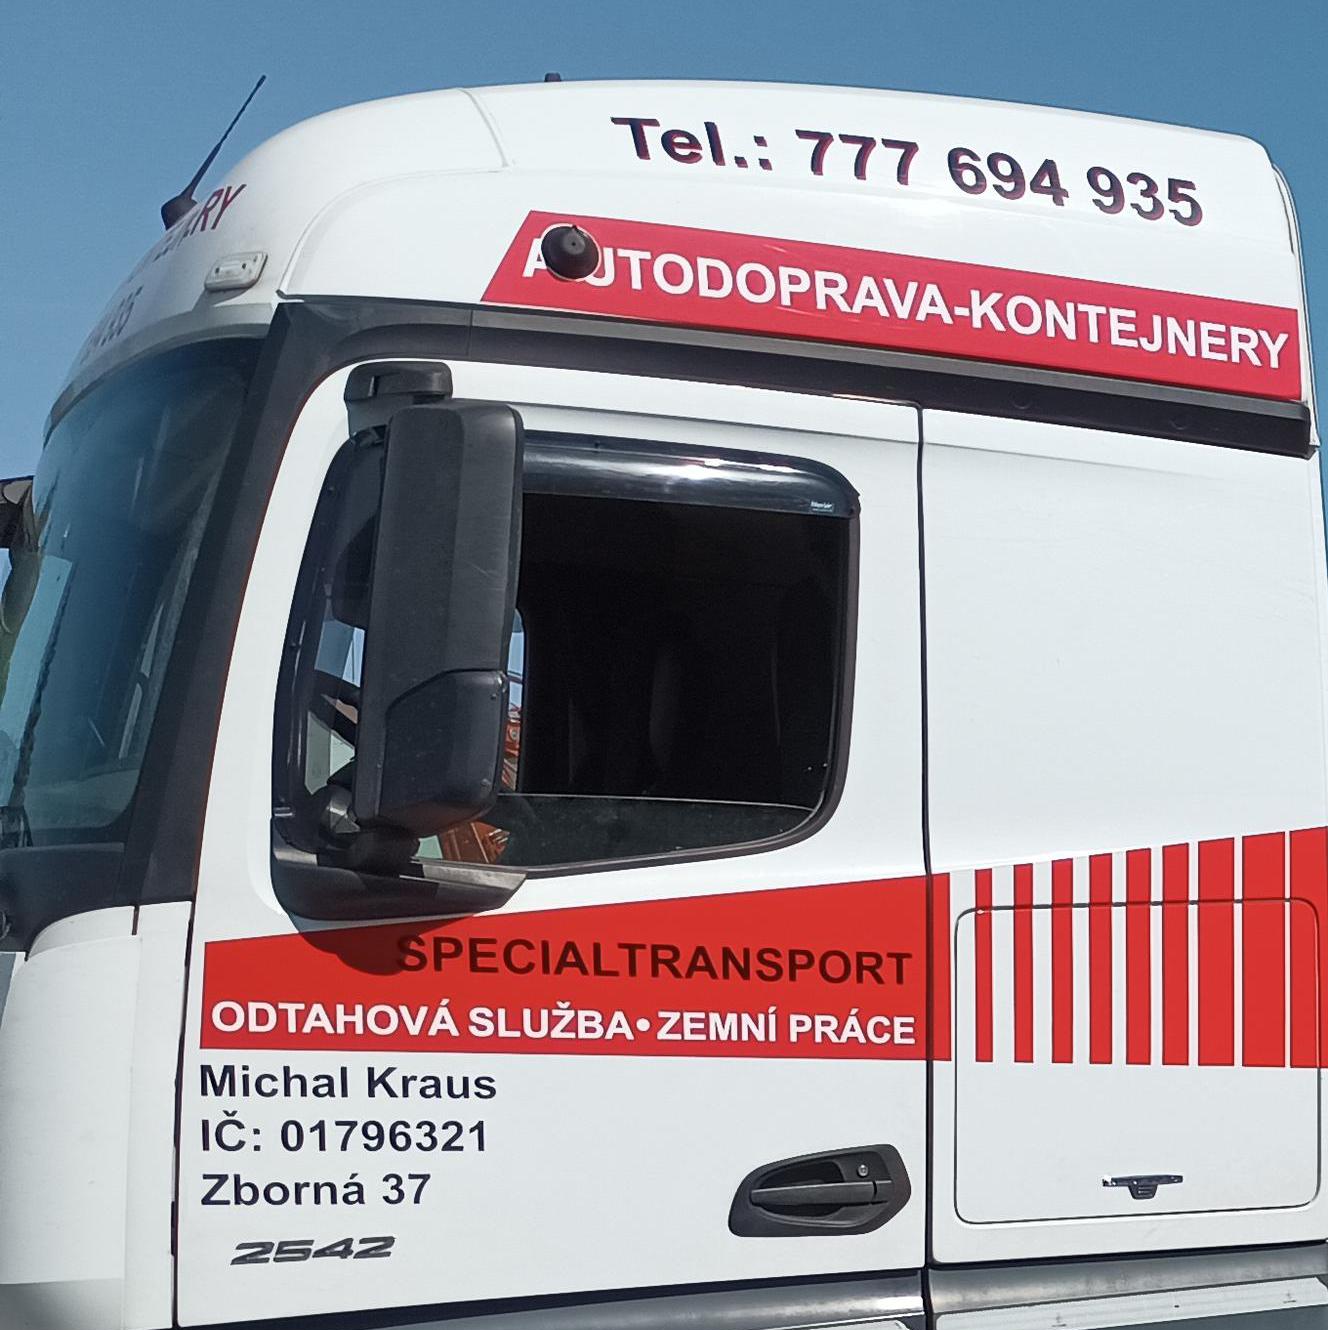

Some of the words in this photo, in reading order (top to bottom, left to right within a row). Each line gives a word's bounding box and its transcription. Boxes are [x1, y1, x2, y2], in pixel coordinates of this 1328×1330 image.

[610, 116, 773, 171] Tel.:
[794, 129, 920, 186] 777
[947, 147, 1070, 207] 694
[1086, 166, 1203, 227] 935
[398, 936, 913, 985] SPECIALTRANSPORT
[211, 998, 460, 1037] ODTAHOVÁ
[789, 1008, 916, 1045] PRÁCE
[200, 1064, 349, 1099] Michal
[366, 1065, 497, 1100] Kraus
[201, 1109, 262, 1152] IČ:
[280, 1119, 486, 1152] 01796321
[201, 1172, 366, 1206] Zborná
[381, 1173, 432, 1206] 37
[230, 1234, 397, 1267] 2542
